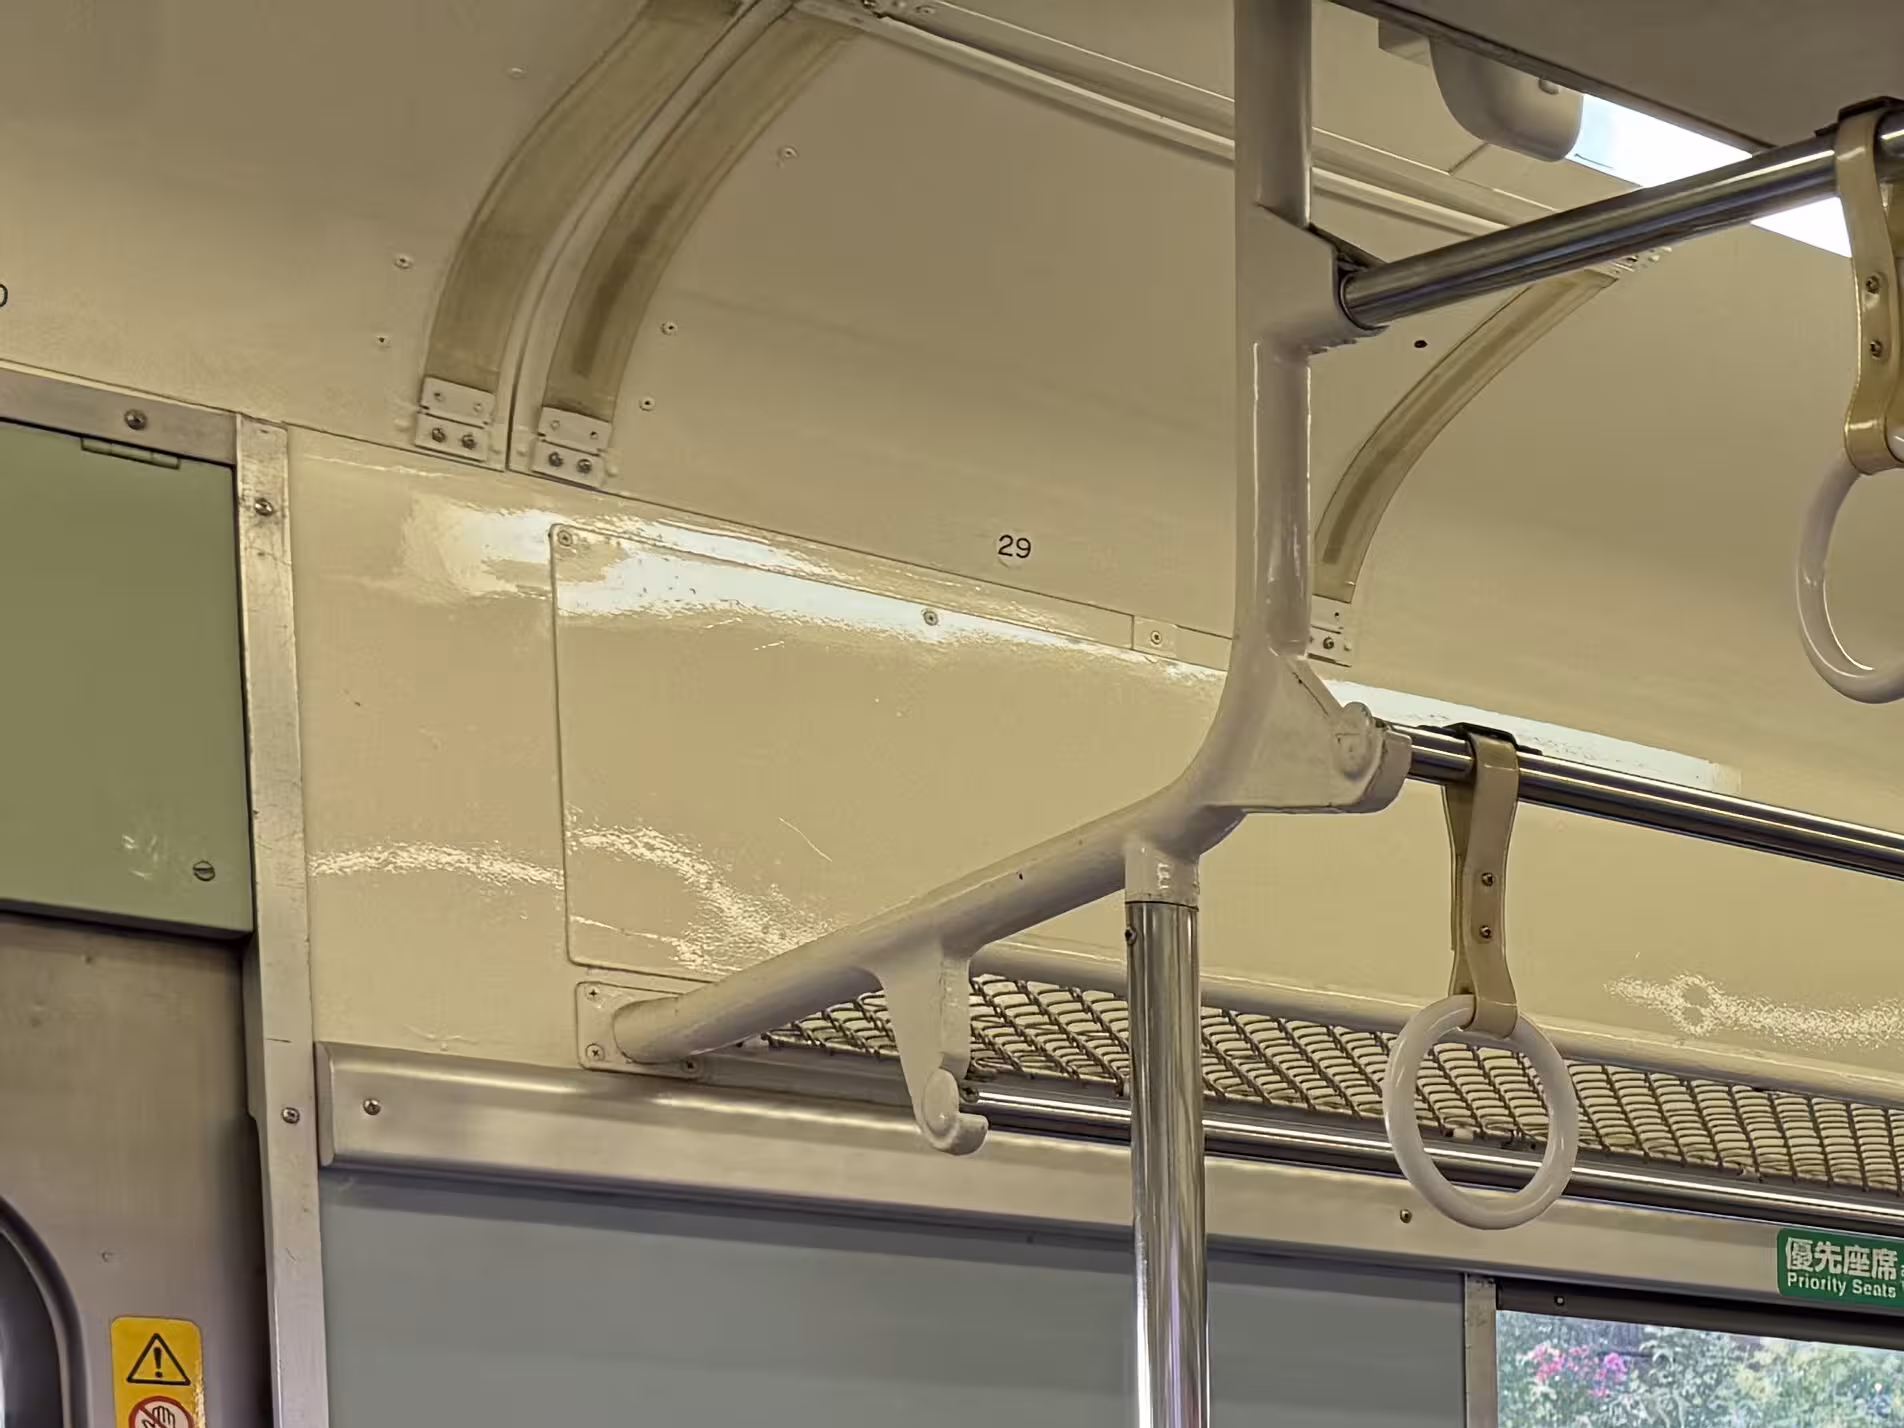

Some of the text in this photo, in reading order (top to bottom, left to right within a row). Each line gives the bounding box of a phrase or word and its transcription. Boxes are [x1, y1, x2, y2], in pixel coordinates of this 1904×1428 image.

[998, 534, 1031, 558] 29
[1786, 1237, 1898, 1280] 優先座席
[1787, 1272, 1896, 1298] Priority Seats
